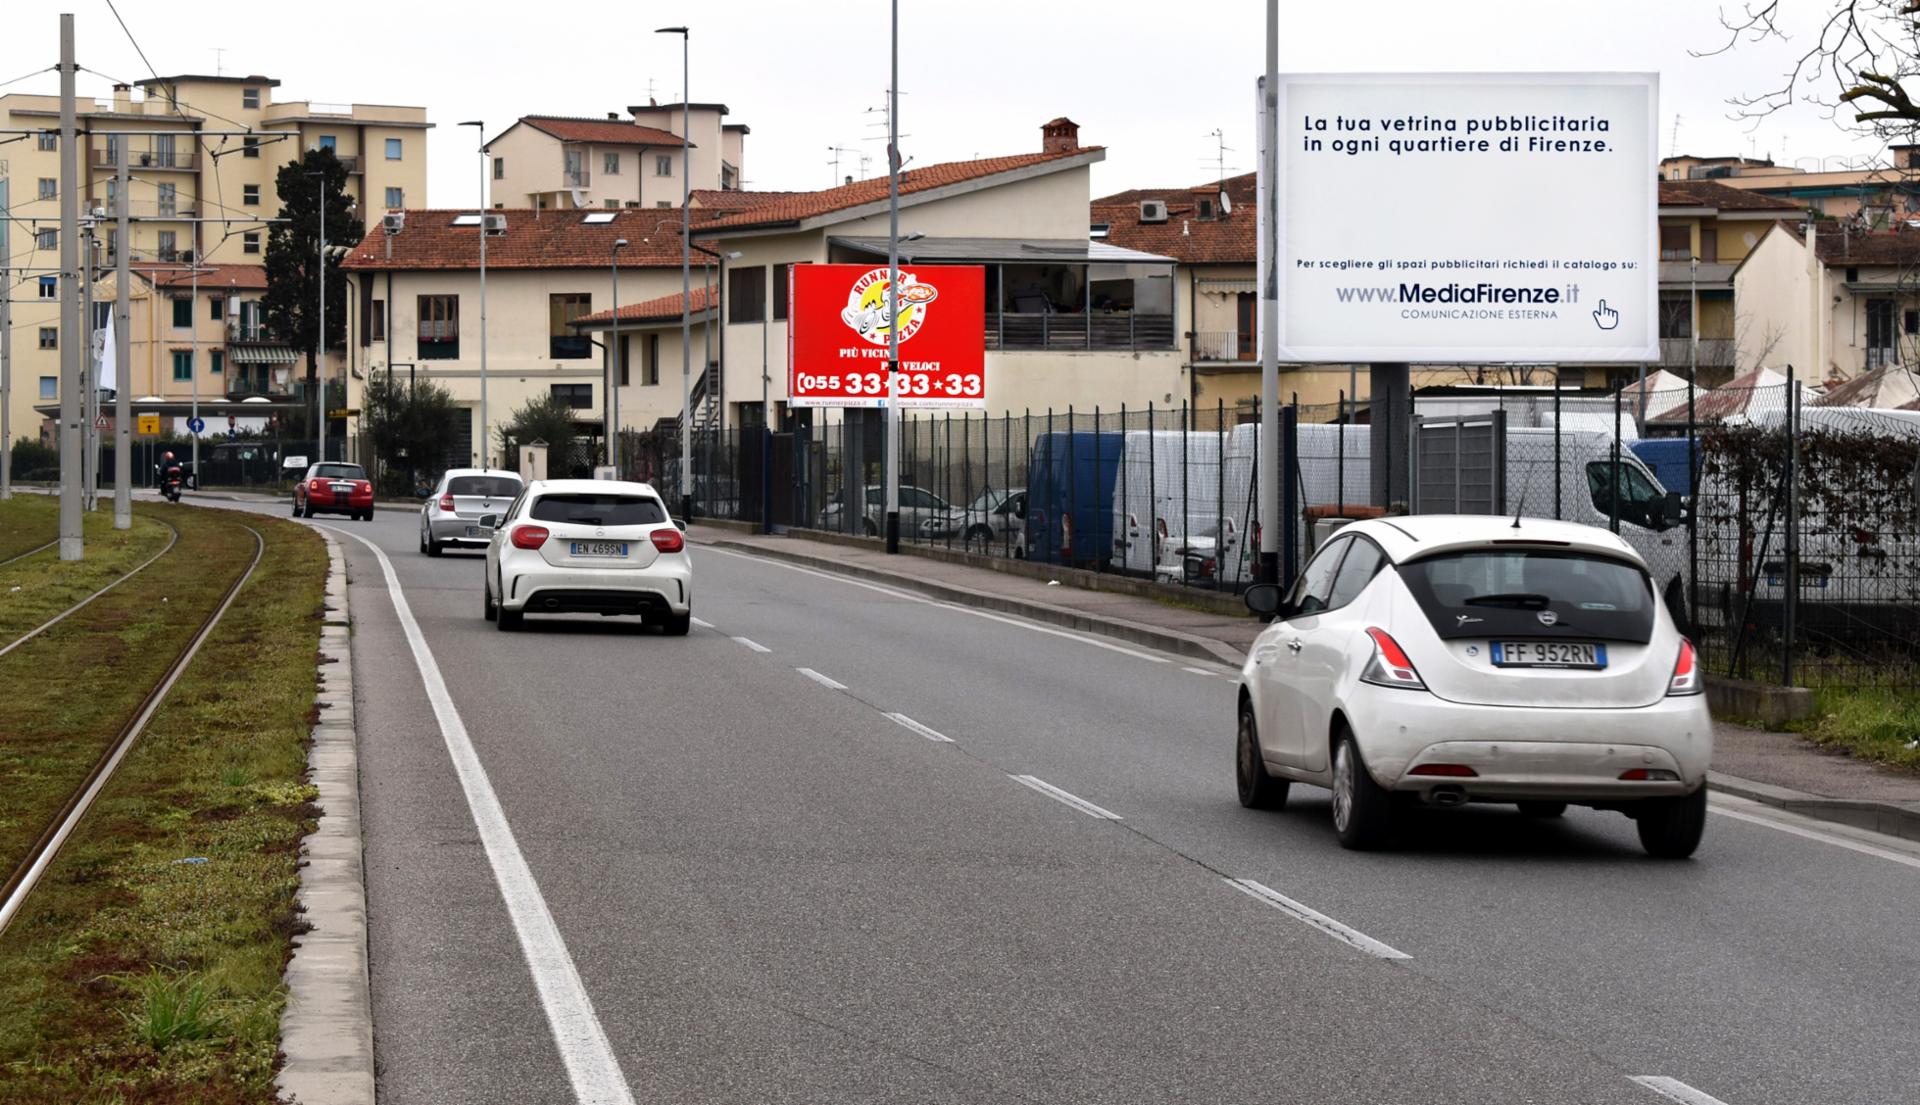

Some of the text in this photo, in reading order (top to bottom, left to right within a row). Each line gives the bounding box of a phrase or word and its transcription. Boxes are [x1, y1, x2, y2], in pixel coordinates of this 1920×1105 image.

[1304, 115, 1609, 135] La tua vetrina pubblicitaria
[1304, 135, 1613, 156] in ogni quartiere di Firenze.
[1297, 259, 1638, 272] Per scegliere gli spazi pubblicitari richiedi il catalogo su:
[854, 270, 907, 295] RUNNR
[1336, 283, 1580, 304] www.MediaFirenze.it
[1401, 309, 1558, 320] COMUNICAZIONE ESTERNA
[884, 320, 920, 343] PZZA
[839, 347, 892, 358] PIÙ VICIN
[902, 362, 941, 371] VELOCI
[803, 376, 841, 389] 055
[577, 543, 622, 555] EN 469SN
[1503, 643, 1595, 663] FF 952RN
